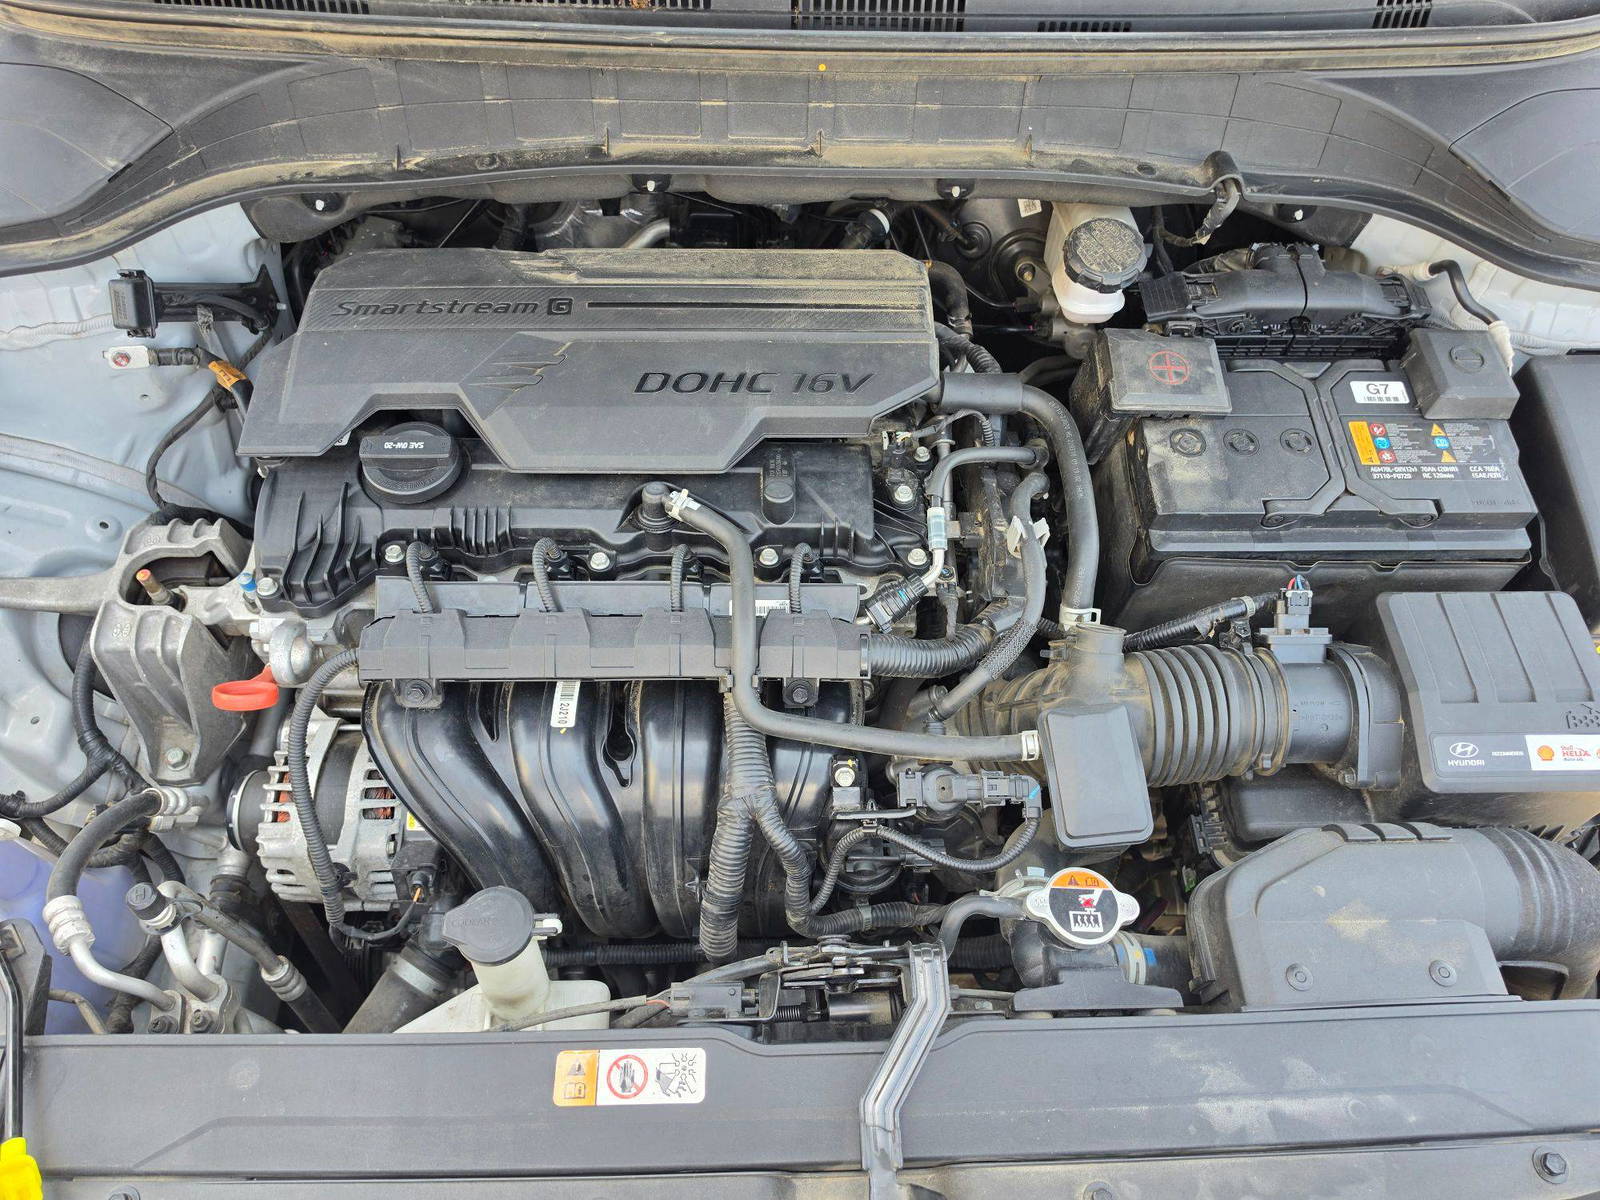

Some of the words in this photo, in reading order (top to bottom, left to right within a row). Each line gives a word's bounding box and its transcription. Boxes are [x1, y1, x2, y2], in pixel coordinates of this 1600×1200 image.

[331, 298, 539, 316] Smartstream
[550, 299, 573, 314] G
[633, 372, 781, 395] DOHC
[791, 372, 877, 395] 16V
[1366, 384, 1389, 395] G7
